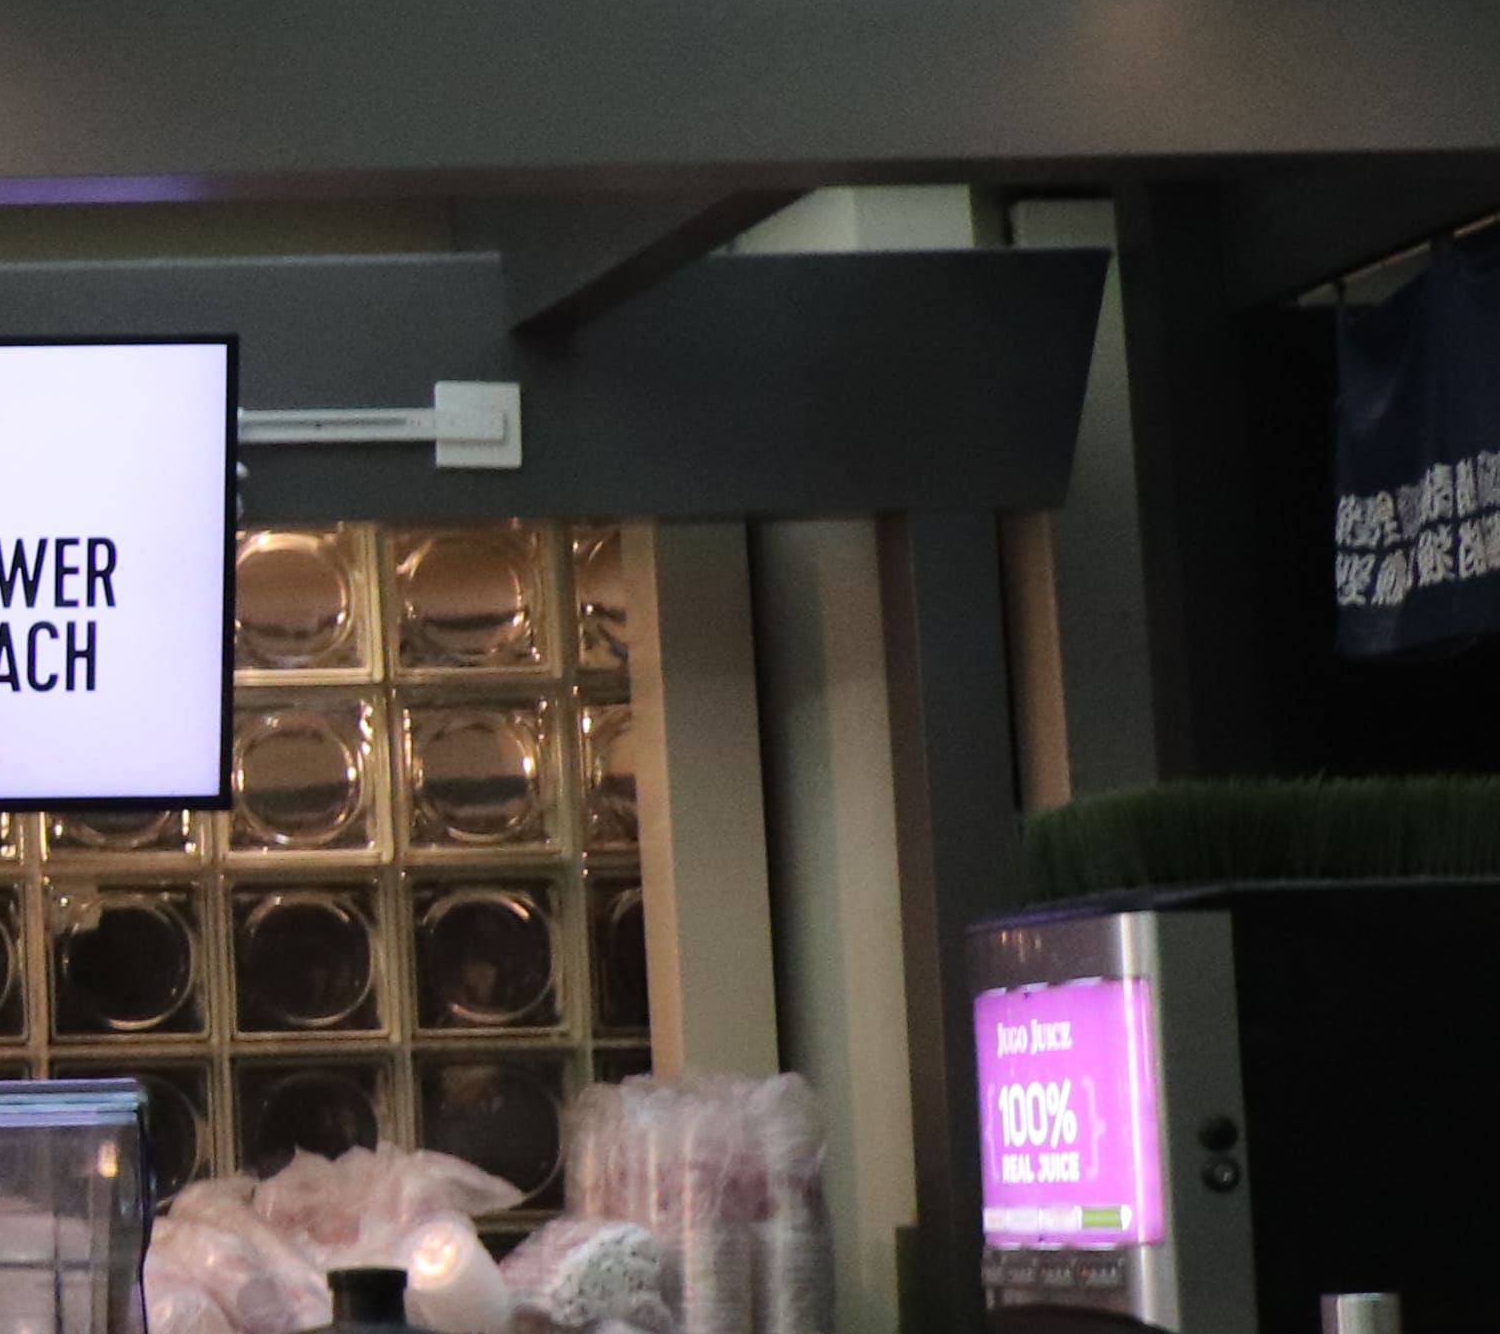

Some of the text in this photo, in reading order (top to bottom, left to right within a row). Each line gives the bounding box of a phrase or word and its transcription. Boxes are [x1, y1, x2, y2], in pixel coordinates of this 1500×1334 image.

[999, 1078, 1077, 1149] 100%
[1002, 1152, 1080, 1183] REAL JUICE
